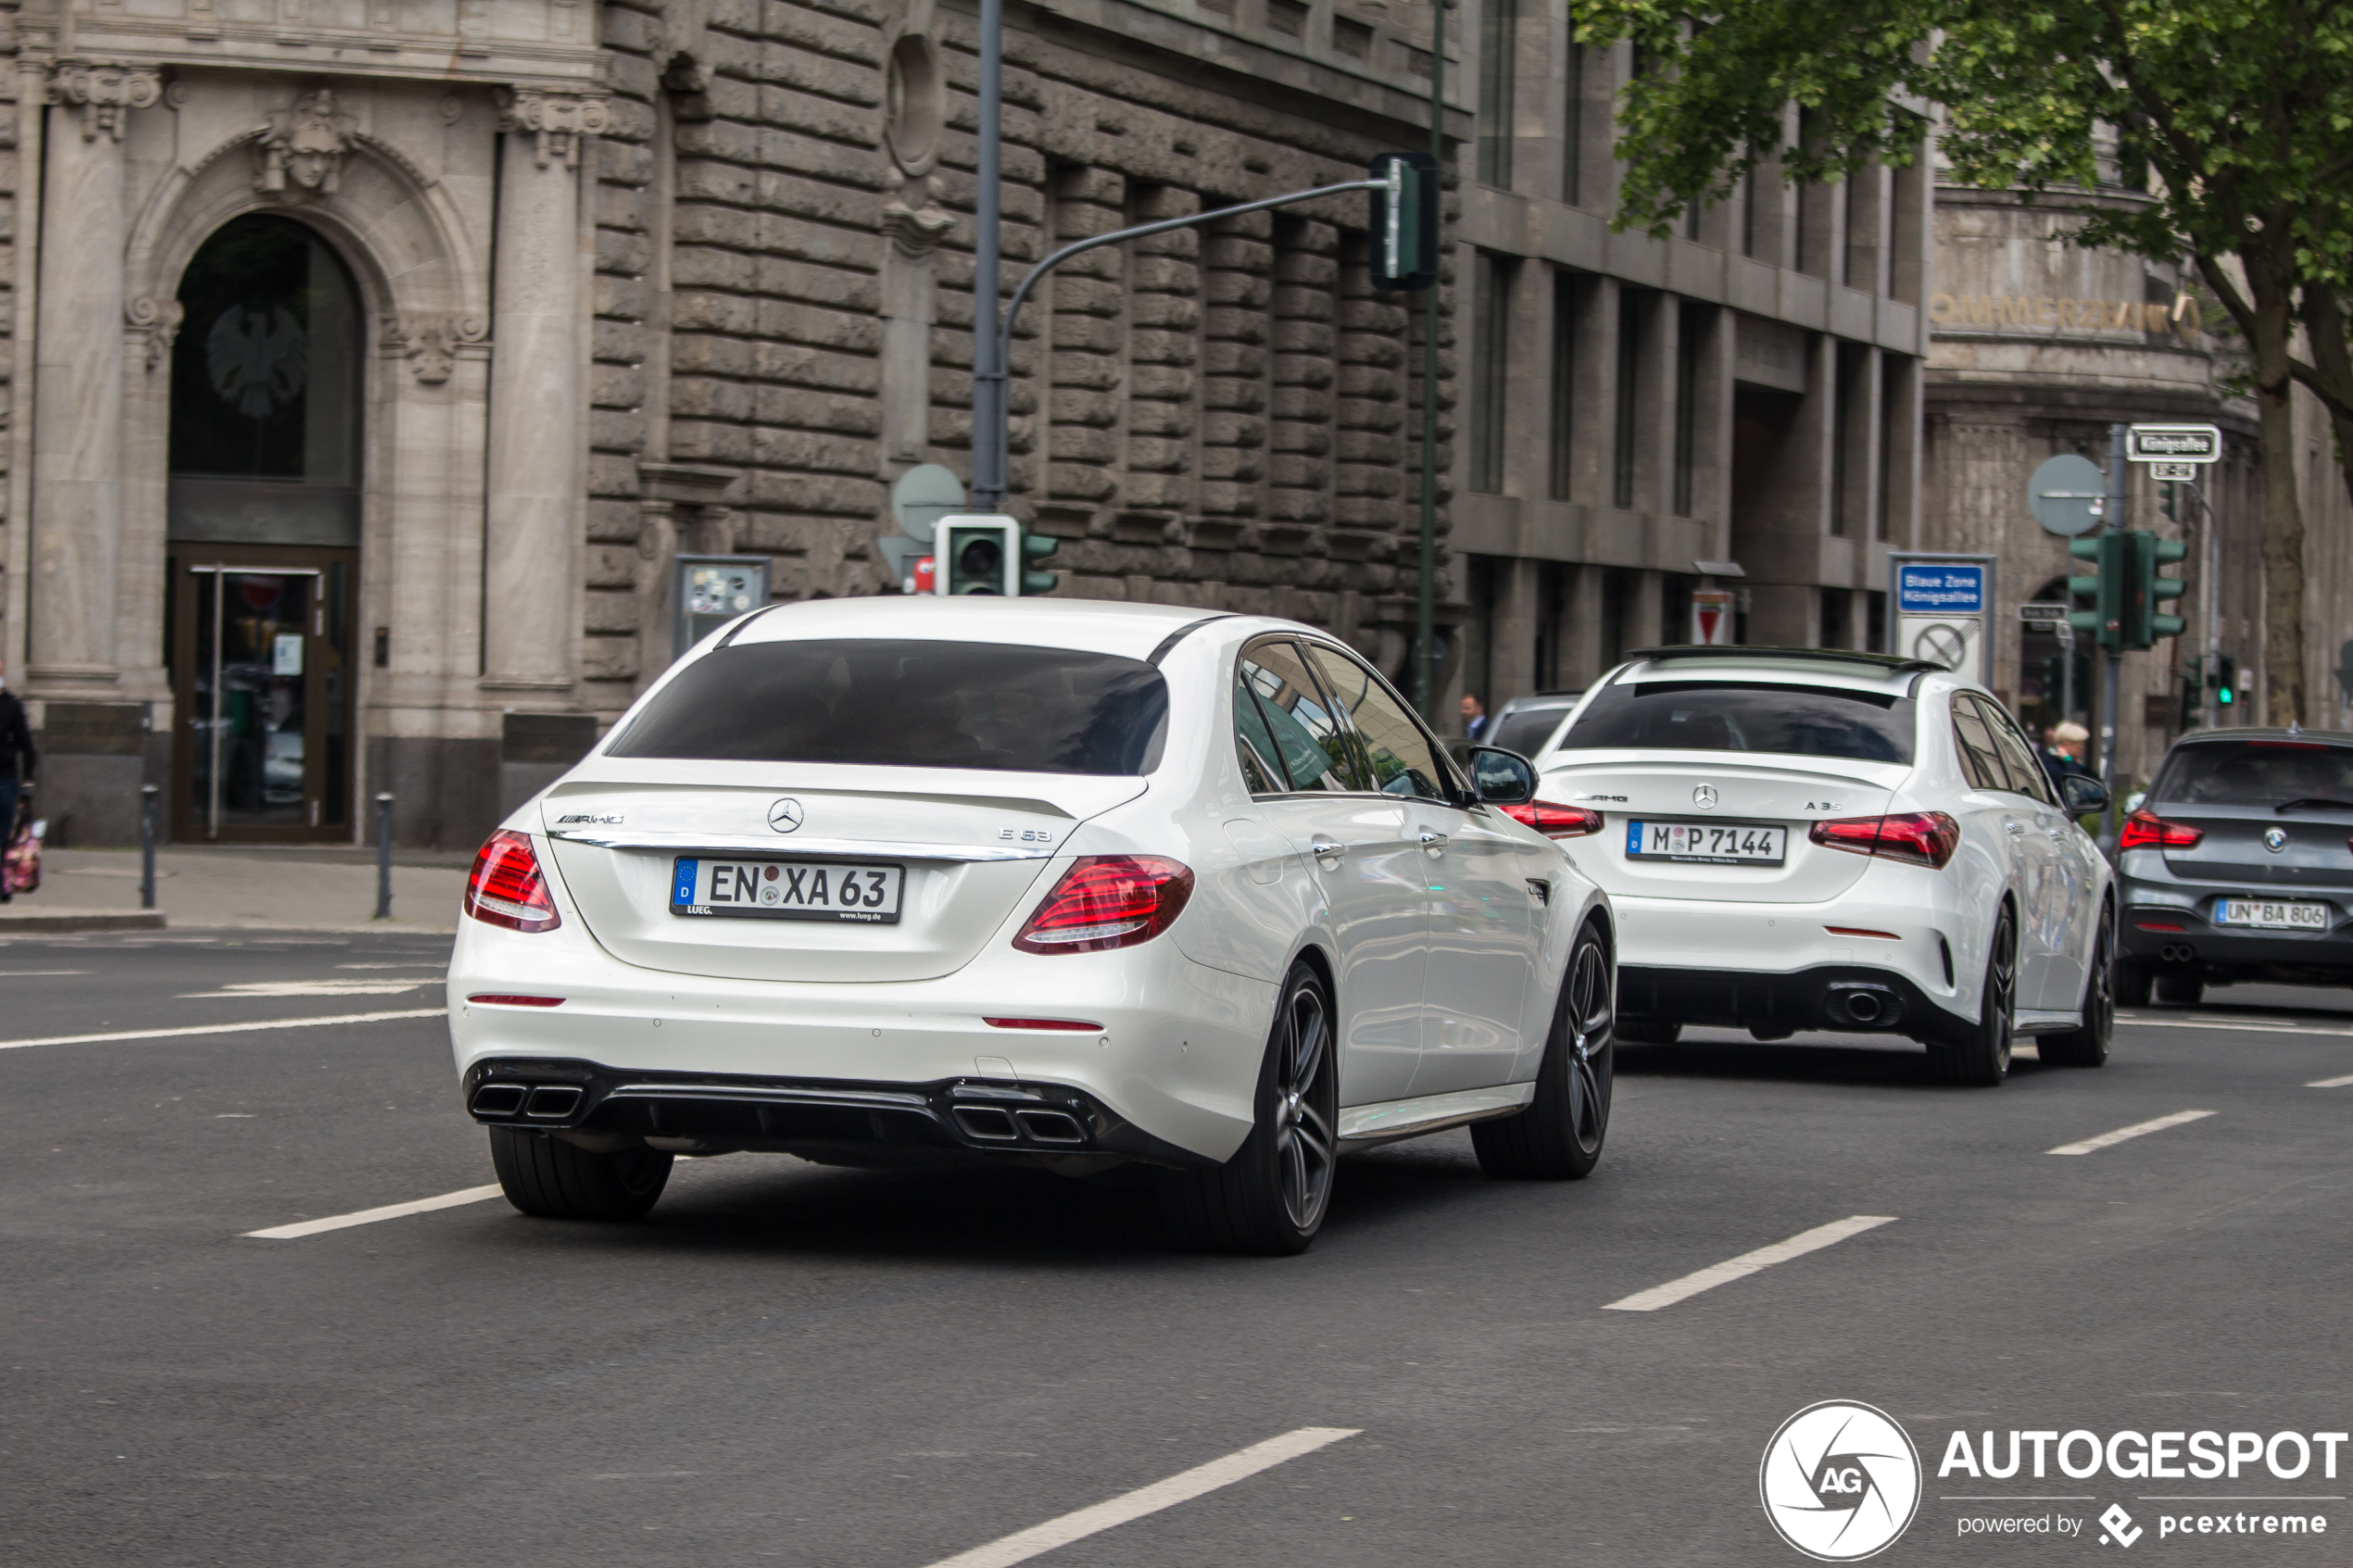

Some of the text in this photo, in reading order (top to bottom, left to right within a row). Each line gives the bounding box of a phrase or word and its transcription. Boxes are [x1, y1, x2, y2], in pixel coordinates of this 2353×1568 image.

[1928, 293, 2172, 334] OMMERZBANK
[2141, 435, 2209, 455] Königsallee
[1905, 574, 1977, 588] Blaue Zone
[1904, 590, 1979, 606] Königsallee
[1592, 795, 1629, 803] AMG
[1804, 801, 1843, 811] A 35
[575, 814, 623, 823] AMG
[999, 827, 1051, 842] E 63
[1653, 826, 1772, 856] M P 7144
[1630, 840, 1639, 848] D
[680, 886, 689, 897] D
[710, 865, 887, 908] EN XA 63
[686, 905, 712, 915] LUEG.
[839, 912, 881, 922] www.lueg.de
[2228, 903, 2251, 920] UN
[2263, 905, 2285, 922] BA
[2290, 907, 2323, 924] 806
